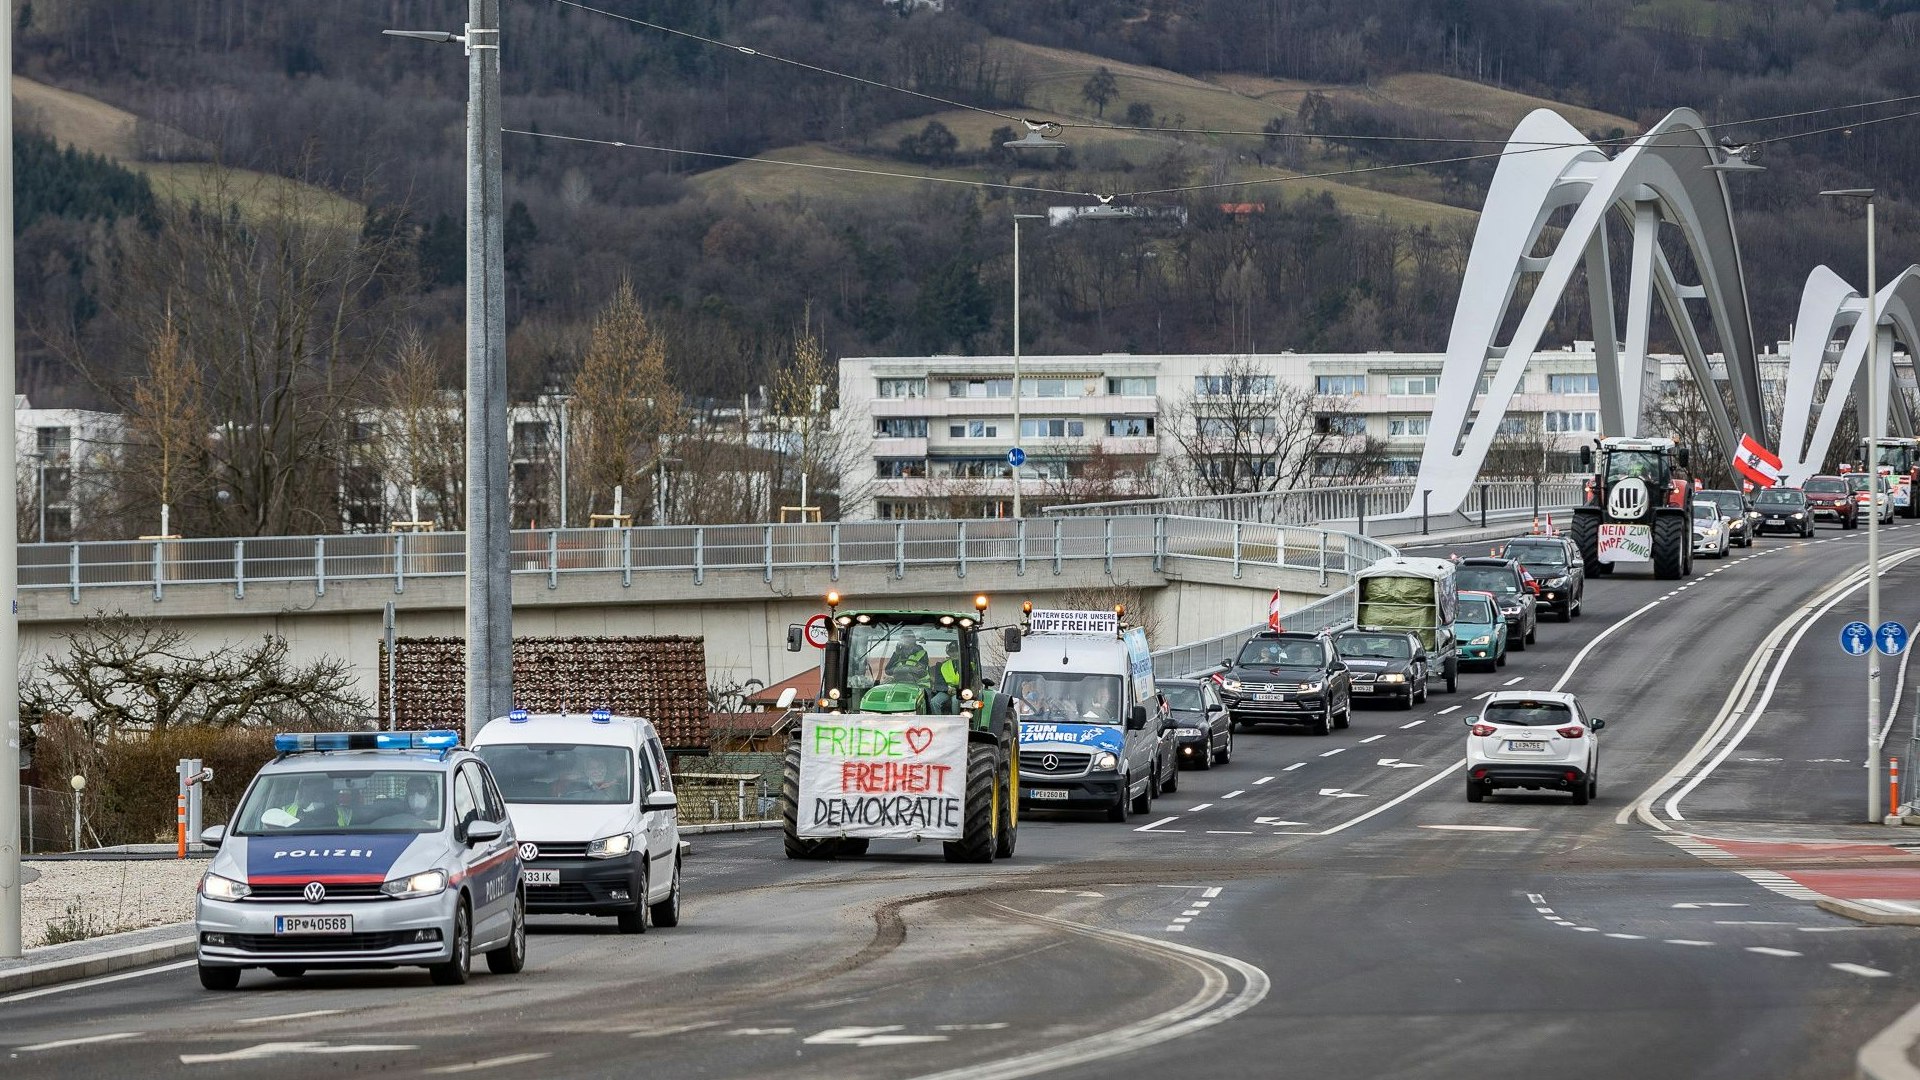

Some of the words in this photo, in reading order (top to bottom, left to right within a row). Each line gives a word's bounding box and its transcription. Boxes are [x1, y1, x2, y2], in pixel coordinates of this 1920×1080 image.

[1602, 525, 1626, 536] NEIN
[1629, 525, 1649, 536] ZUM
[1600, 537, 1650, 558] IMPFZWANG
[1032, 612, 1074, 620] UNTERWEGS
[1075, 612, 1088, 620] FÜR
[1026, 725, 1058, 733] ZUM
[815, 725, 903, 757] FRIEDE
[842, 761, 951, 793] FREIHEIT
[814, 796, 960, 828] DEMOKRATIE
[274, 849, 373, 859] POLIZEI
[542, 872, 552, 882] IK
[310, 918, 347, 930] 40568
